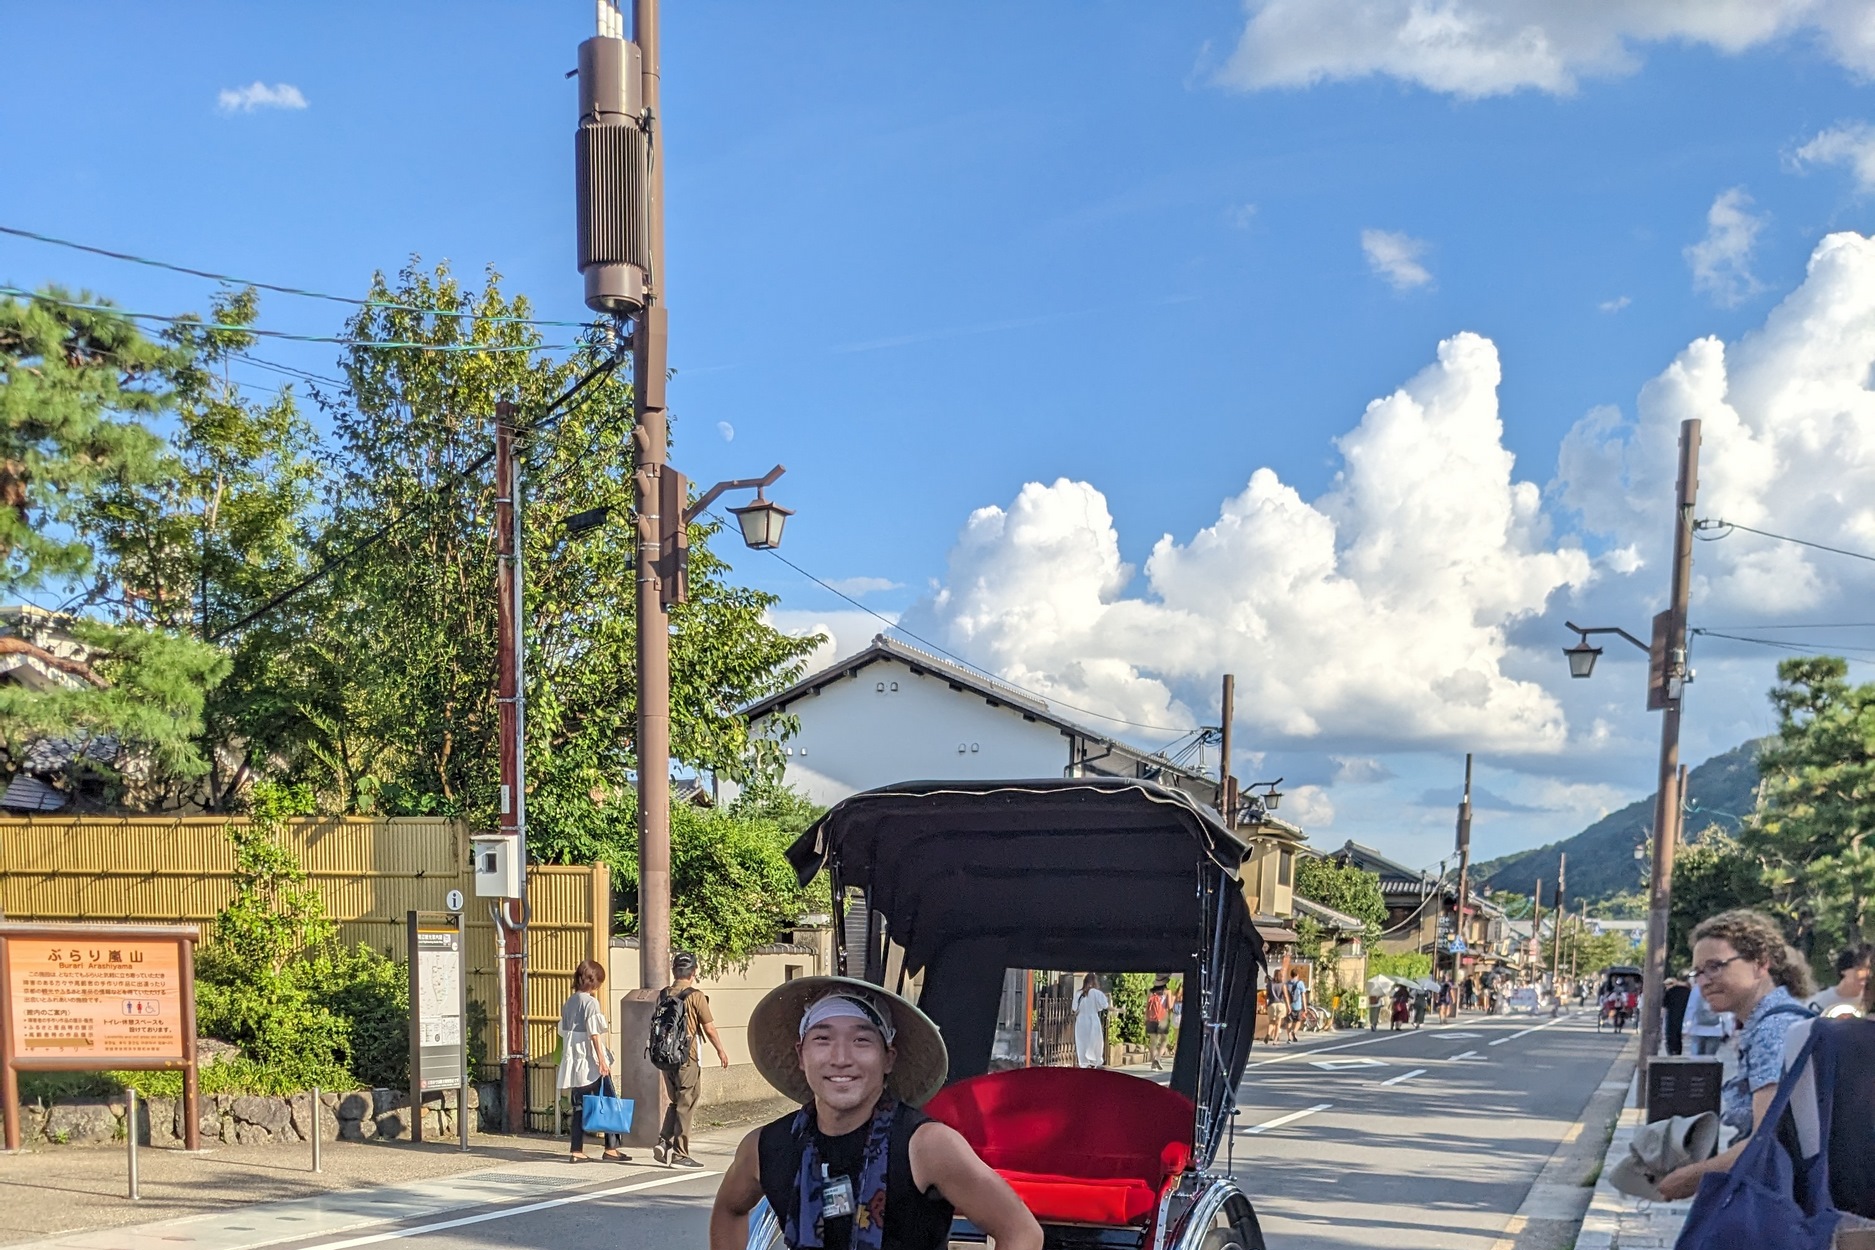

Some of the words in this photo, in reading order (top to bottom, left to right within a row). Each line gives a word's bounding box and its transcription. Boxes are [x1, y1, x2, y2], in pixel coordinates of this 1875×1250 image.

[48, 948, 143, 963] ぶらり嵐山
[58, 962, 84, 970] Burari
